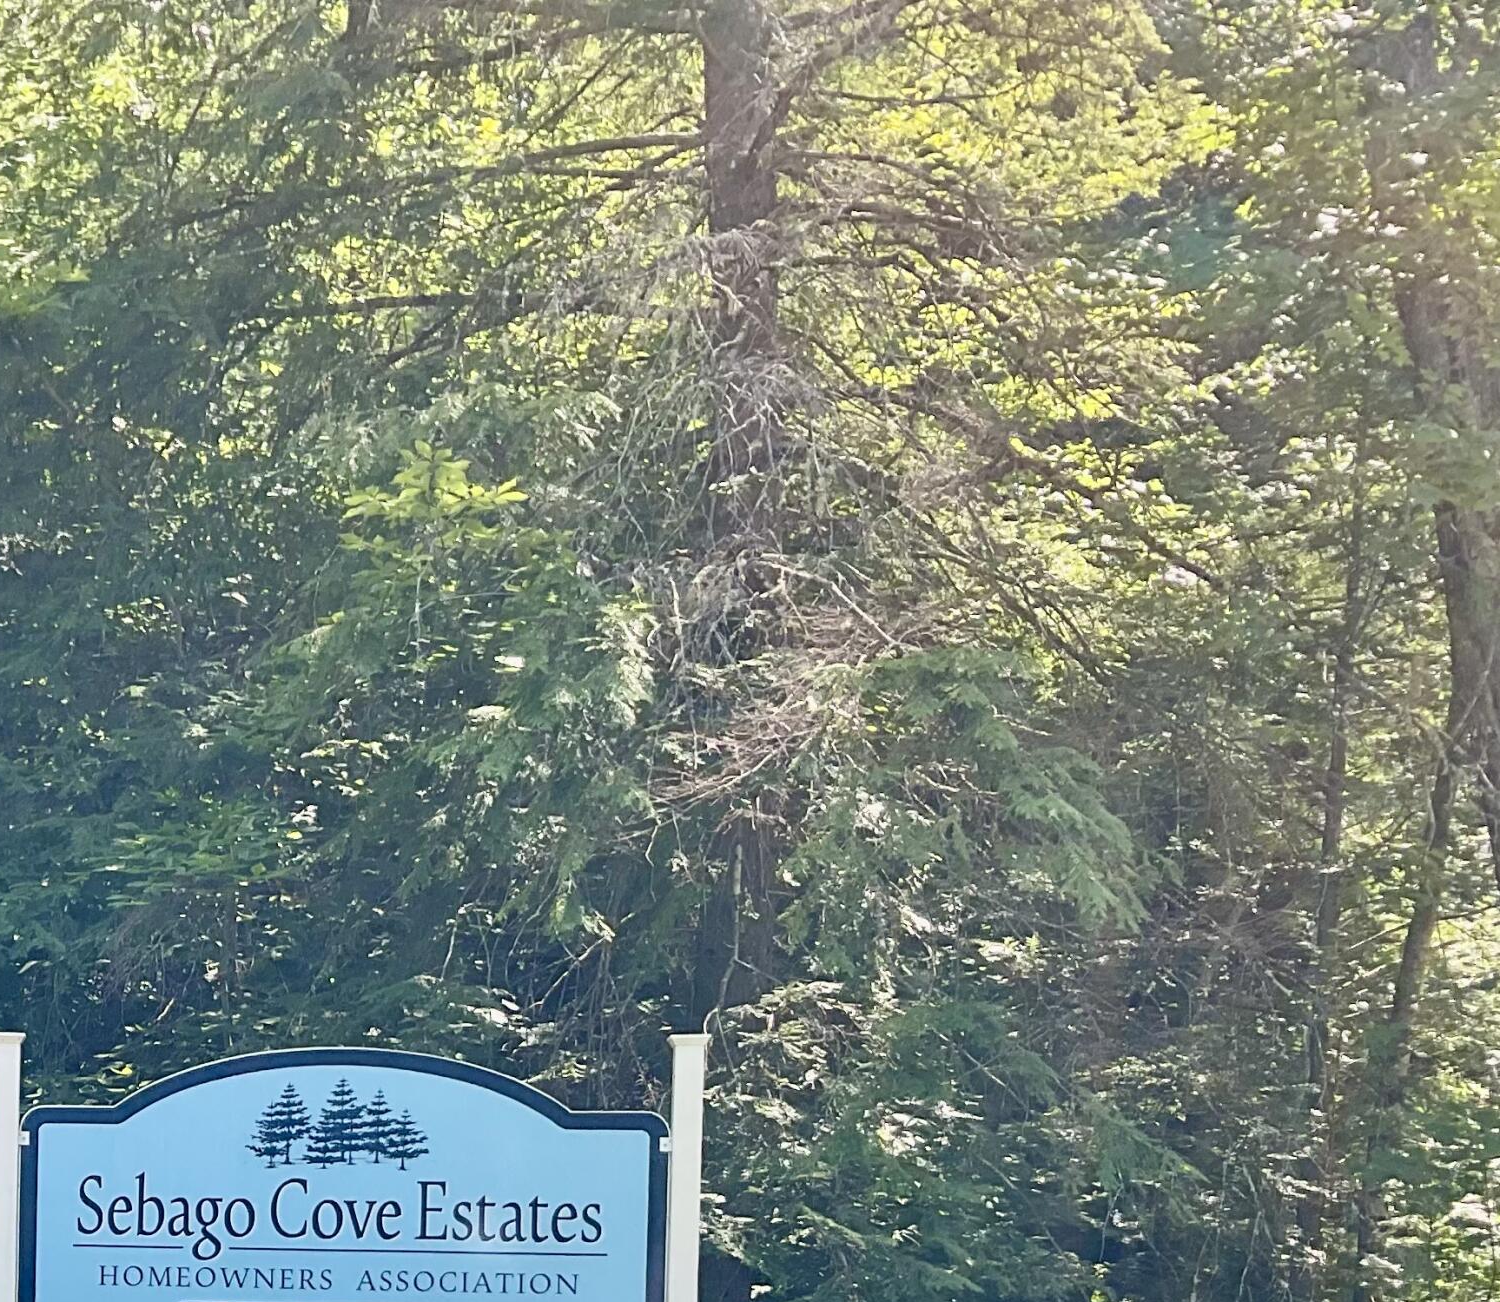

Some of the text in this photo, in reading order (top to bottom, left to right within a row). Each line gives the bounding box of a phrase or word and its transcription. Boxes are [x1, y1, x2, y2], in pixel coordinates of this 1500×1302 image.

[76, 1172, 603, 1260] Sebago Cove Estates
[98, 1264, 581, 1297] HOMEOWNERS ASSOCIATION
